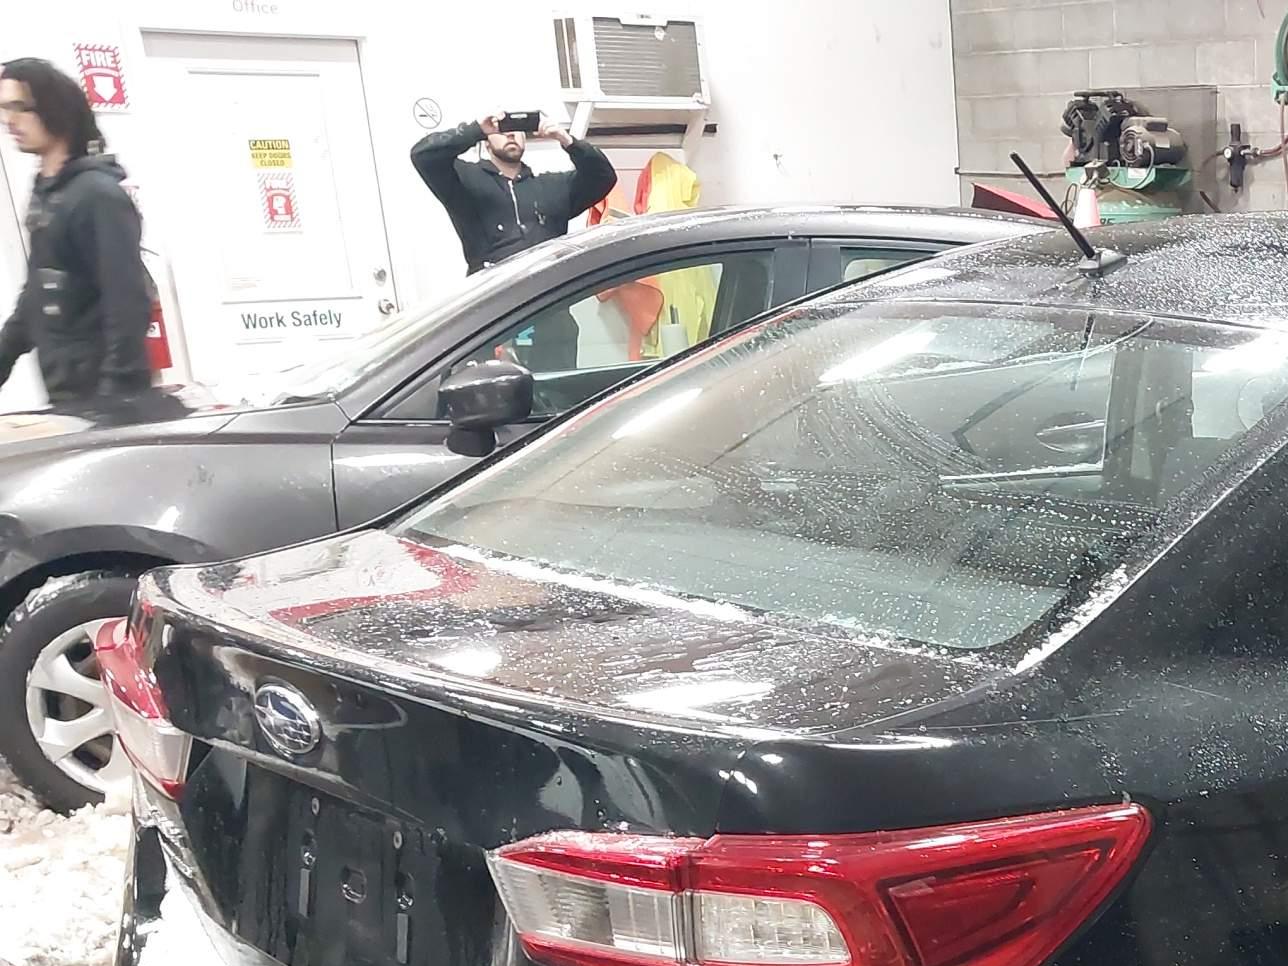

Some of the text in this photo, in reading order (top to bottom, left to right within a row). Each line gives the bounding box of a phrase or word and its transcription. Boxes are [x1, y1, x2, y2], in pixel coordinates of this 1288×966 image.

[80, 49, 117, 68] FIRE
[249, 140, 290, 150] CAUTION
[241, 309, 342, 329] Work Safely
